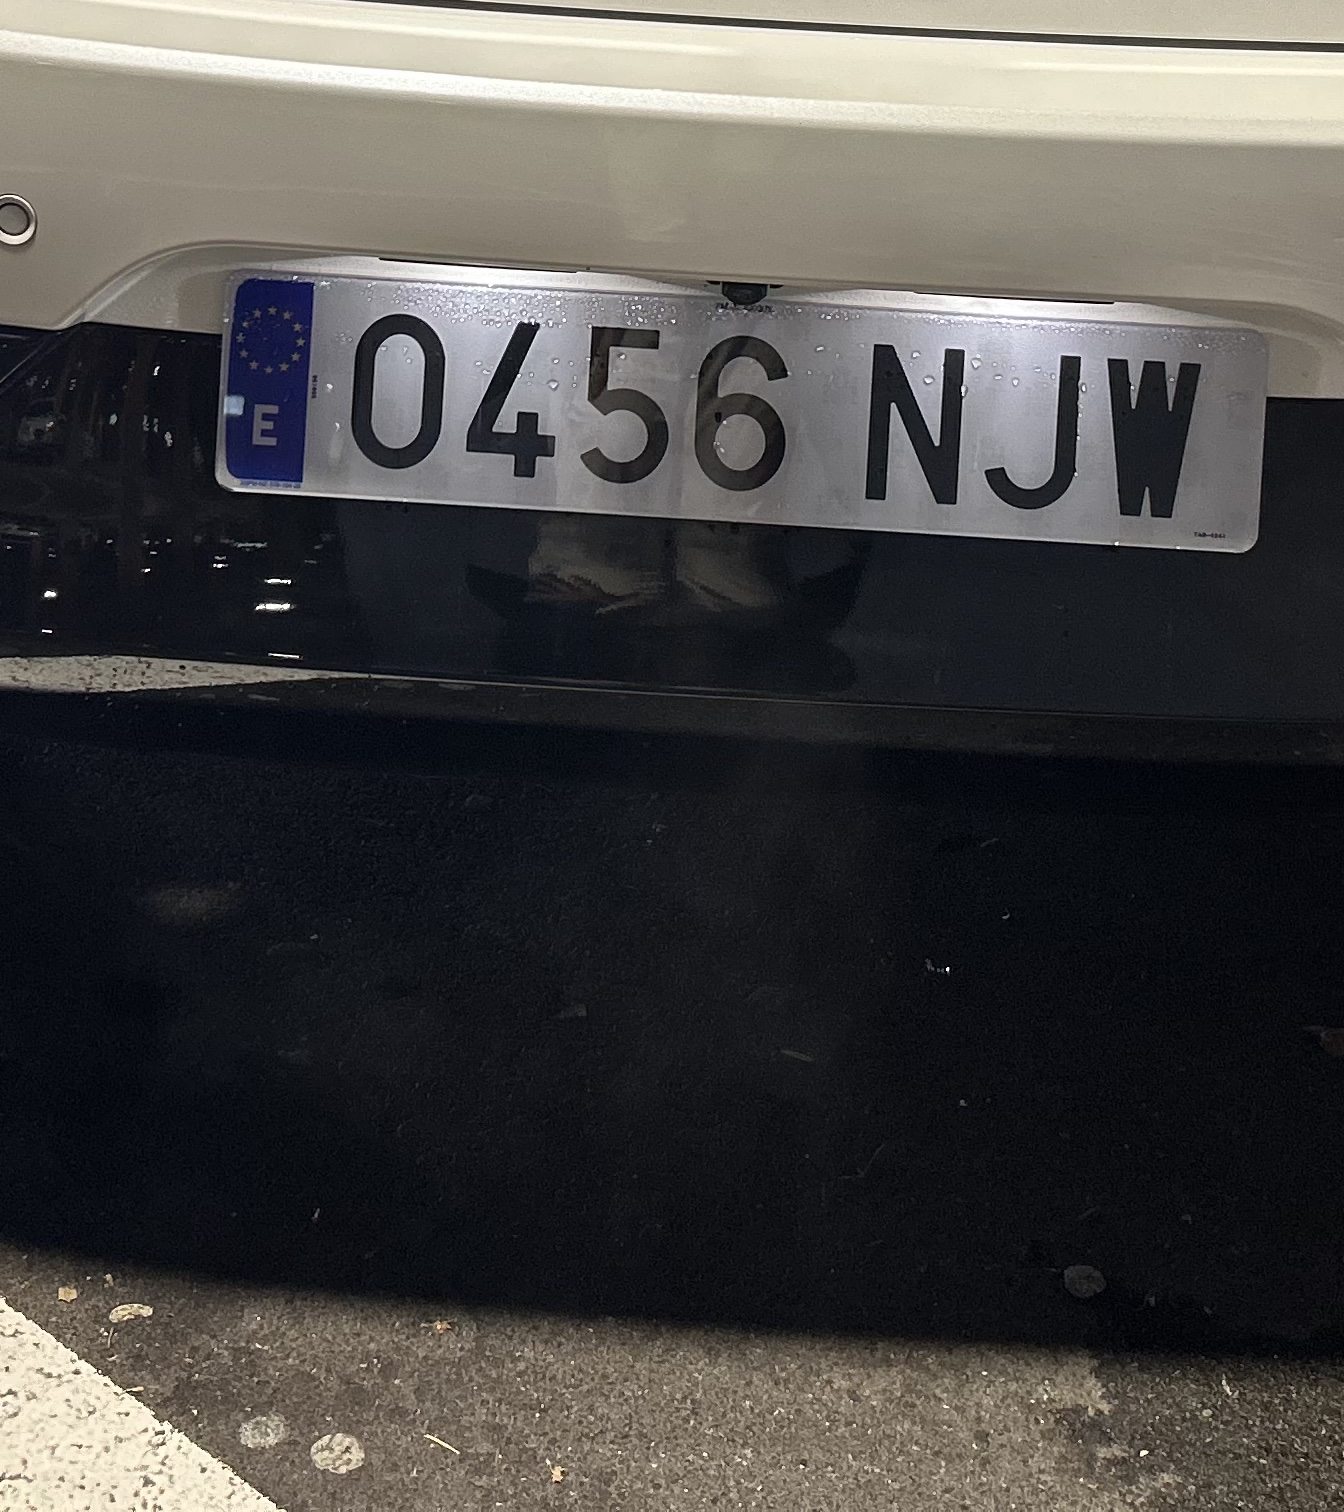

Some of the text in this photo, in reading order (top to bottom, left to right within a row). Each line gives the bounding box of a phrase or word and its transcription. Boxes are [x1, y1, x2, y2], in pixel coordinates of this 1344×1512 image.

[251, 403, 279, 446] E
[350, 314, 1202, 518] 0456 NJW
